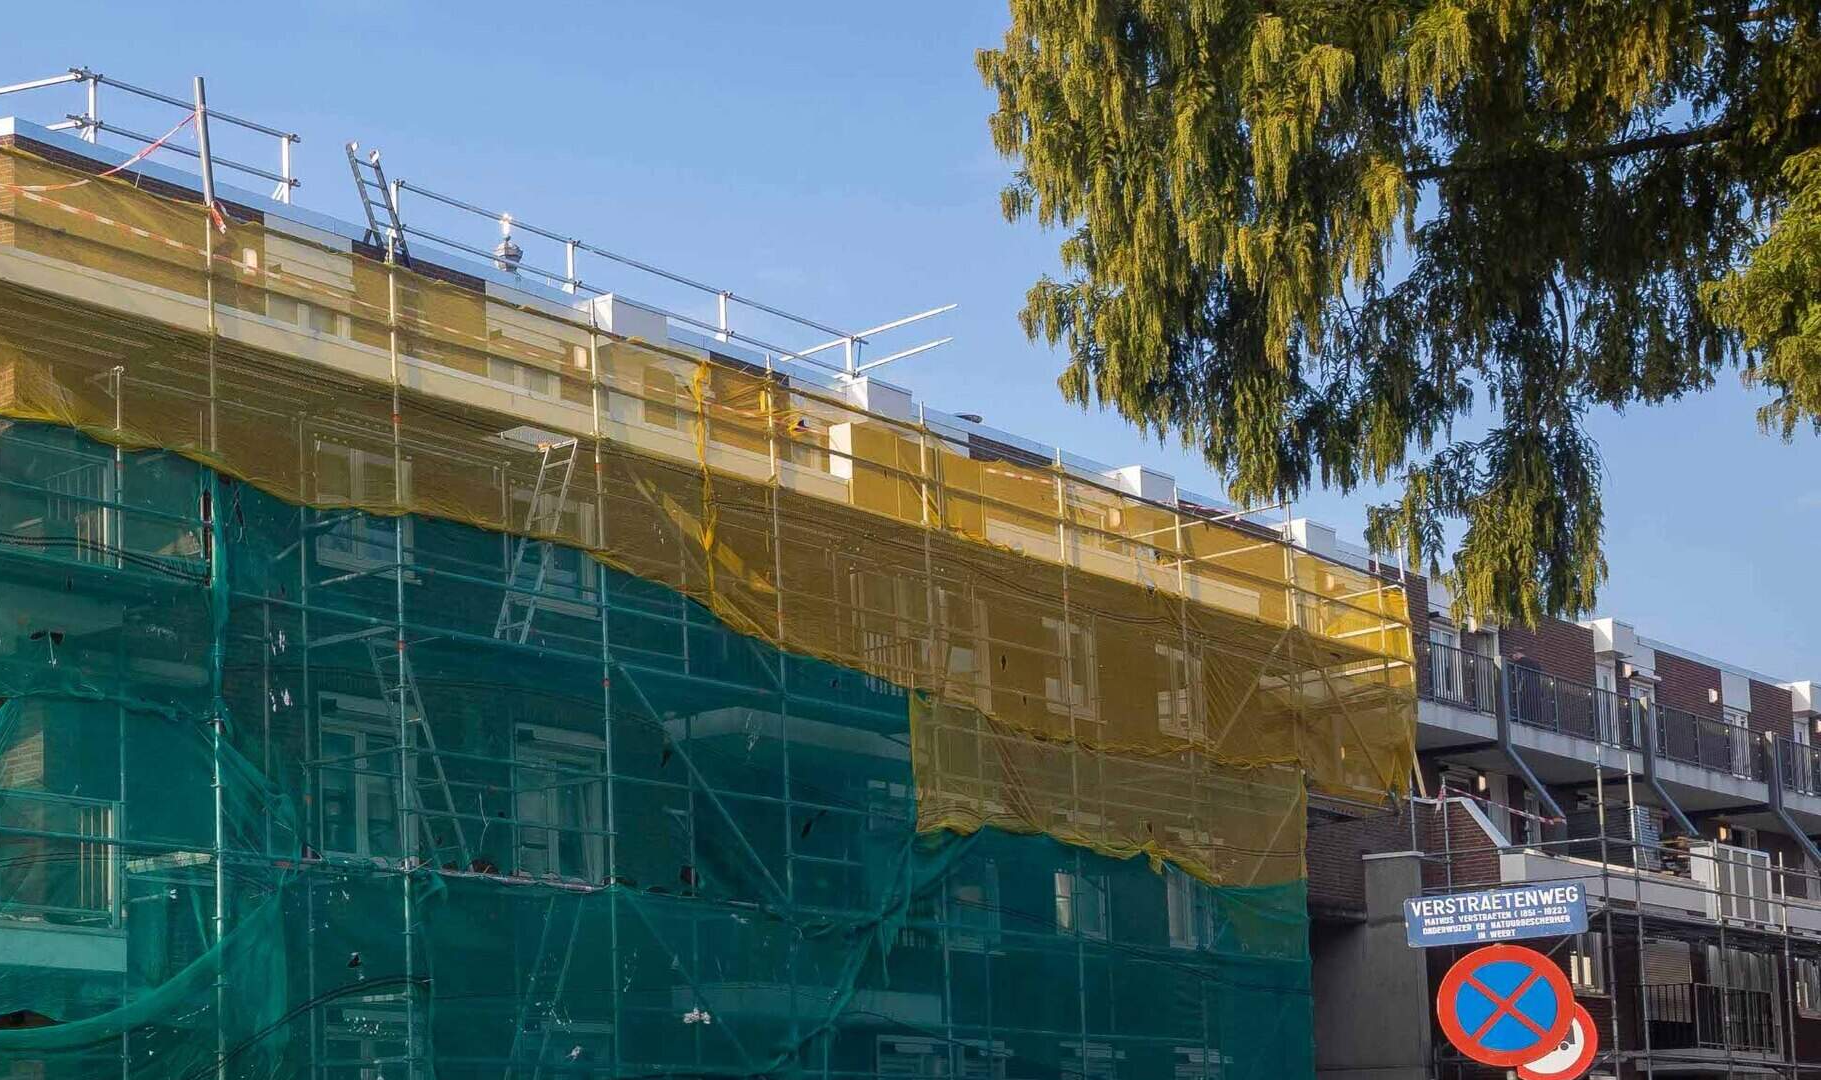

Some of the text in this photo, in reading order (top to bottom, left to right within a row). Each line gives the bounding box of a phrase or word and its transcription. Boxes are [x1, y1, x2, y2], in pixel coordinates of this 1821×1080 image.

[1410, 886, 1578, 917] VERSTRAETENWEG
[1458, 911, 1512, 924] VERSTRAETEN
[1490, 929, 1516, 938] WEERT
